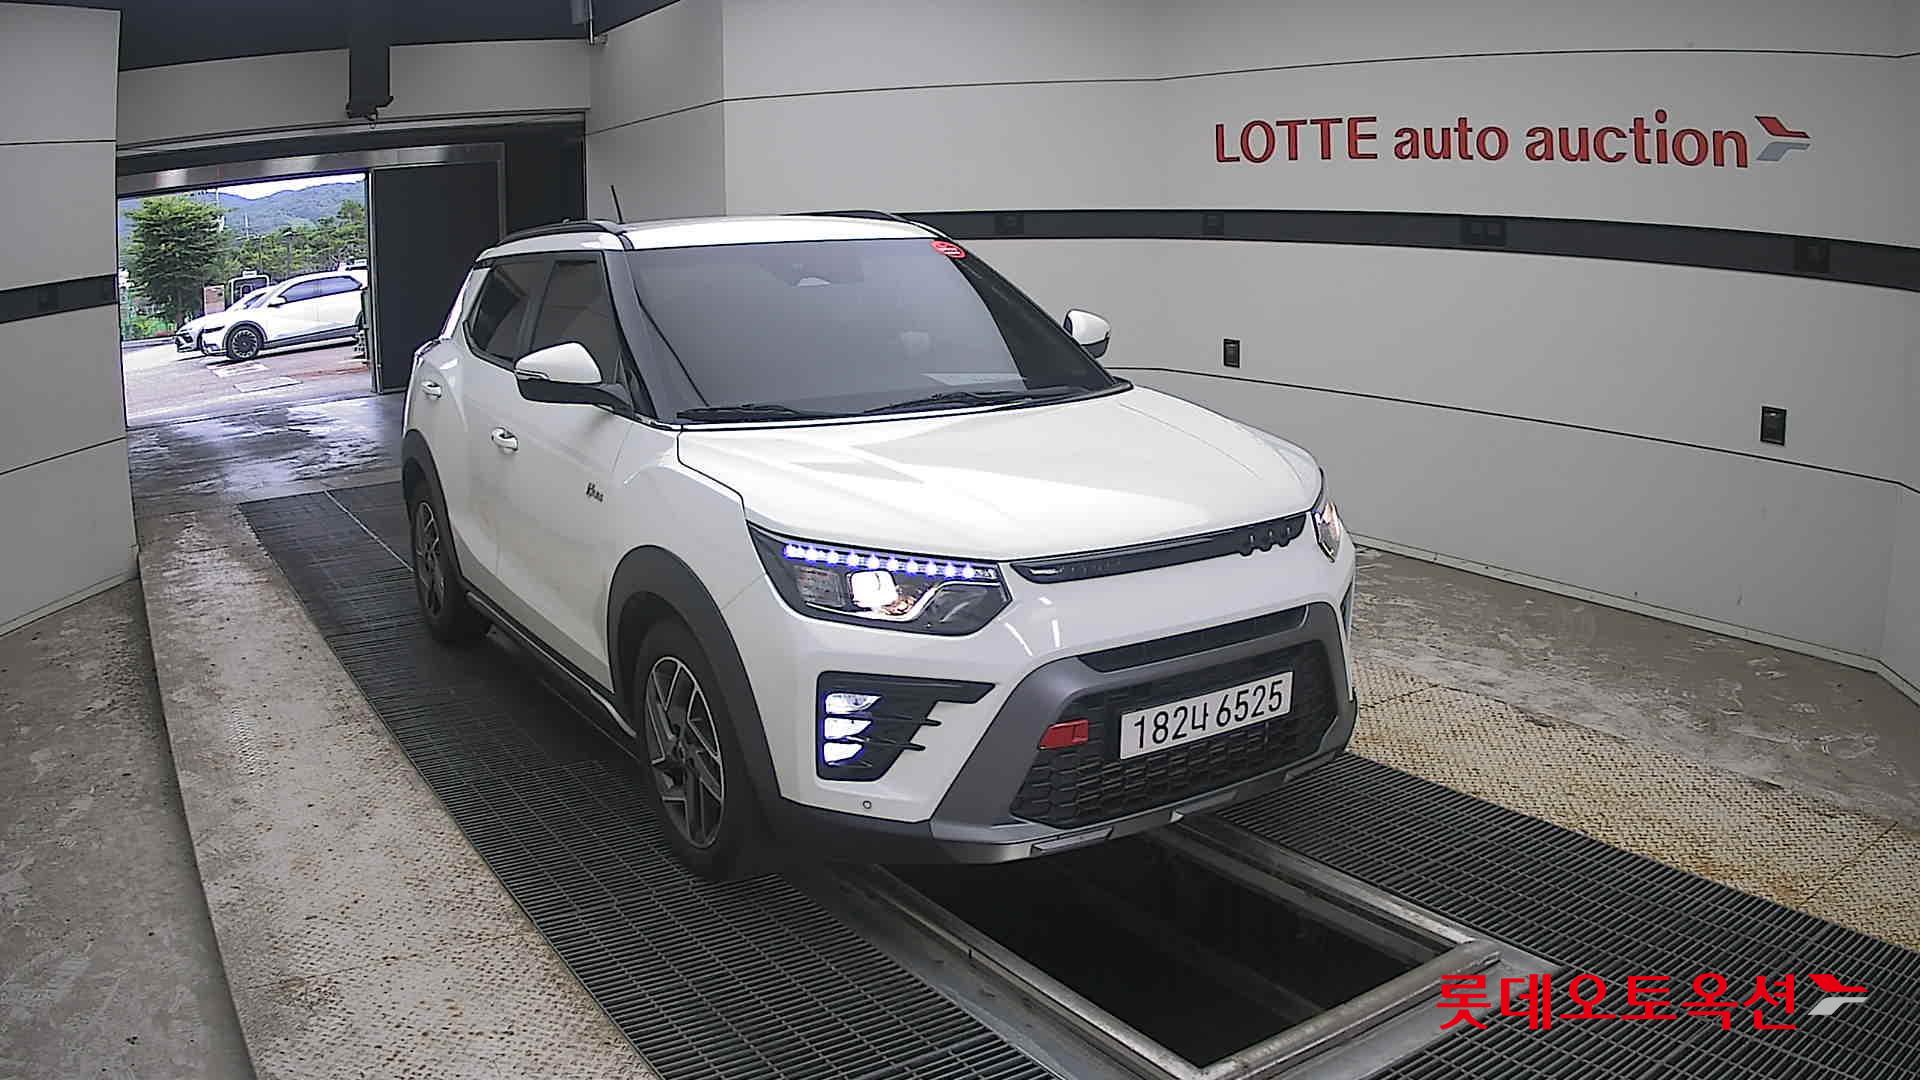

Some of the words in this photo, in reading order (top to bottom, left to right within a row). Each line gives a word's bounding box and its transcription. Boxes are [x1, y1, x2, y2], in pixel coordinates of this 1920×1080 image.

[1215, 116, 1377, 162] LOTTE
[1393, 117, 1511, 161] auto
[1524, 110, 1749, 168] auction
[1134, 702, 1209, 749] 182나
[1215, 679, 1283, 728] 6525
